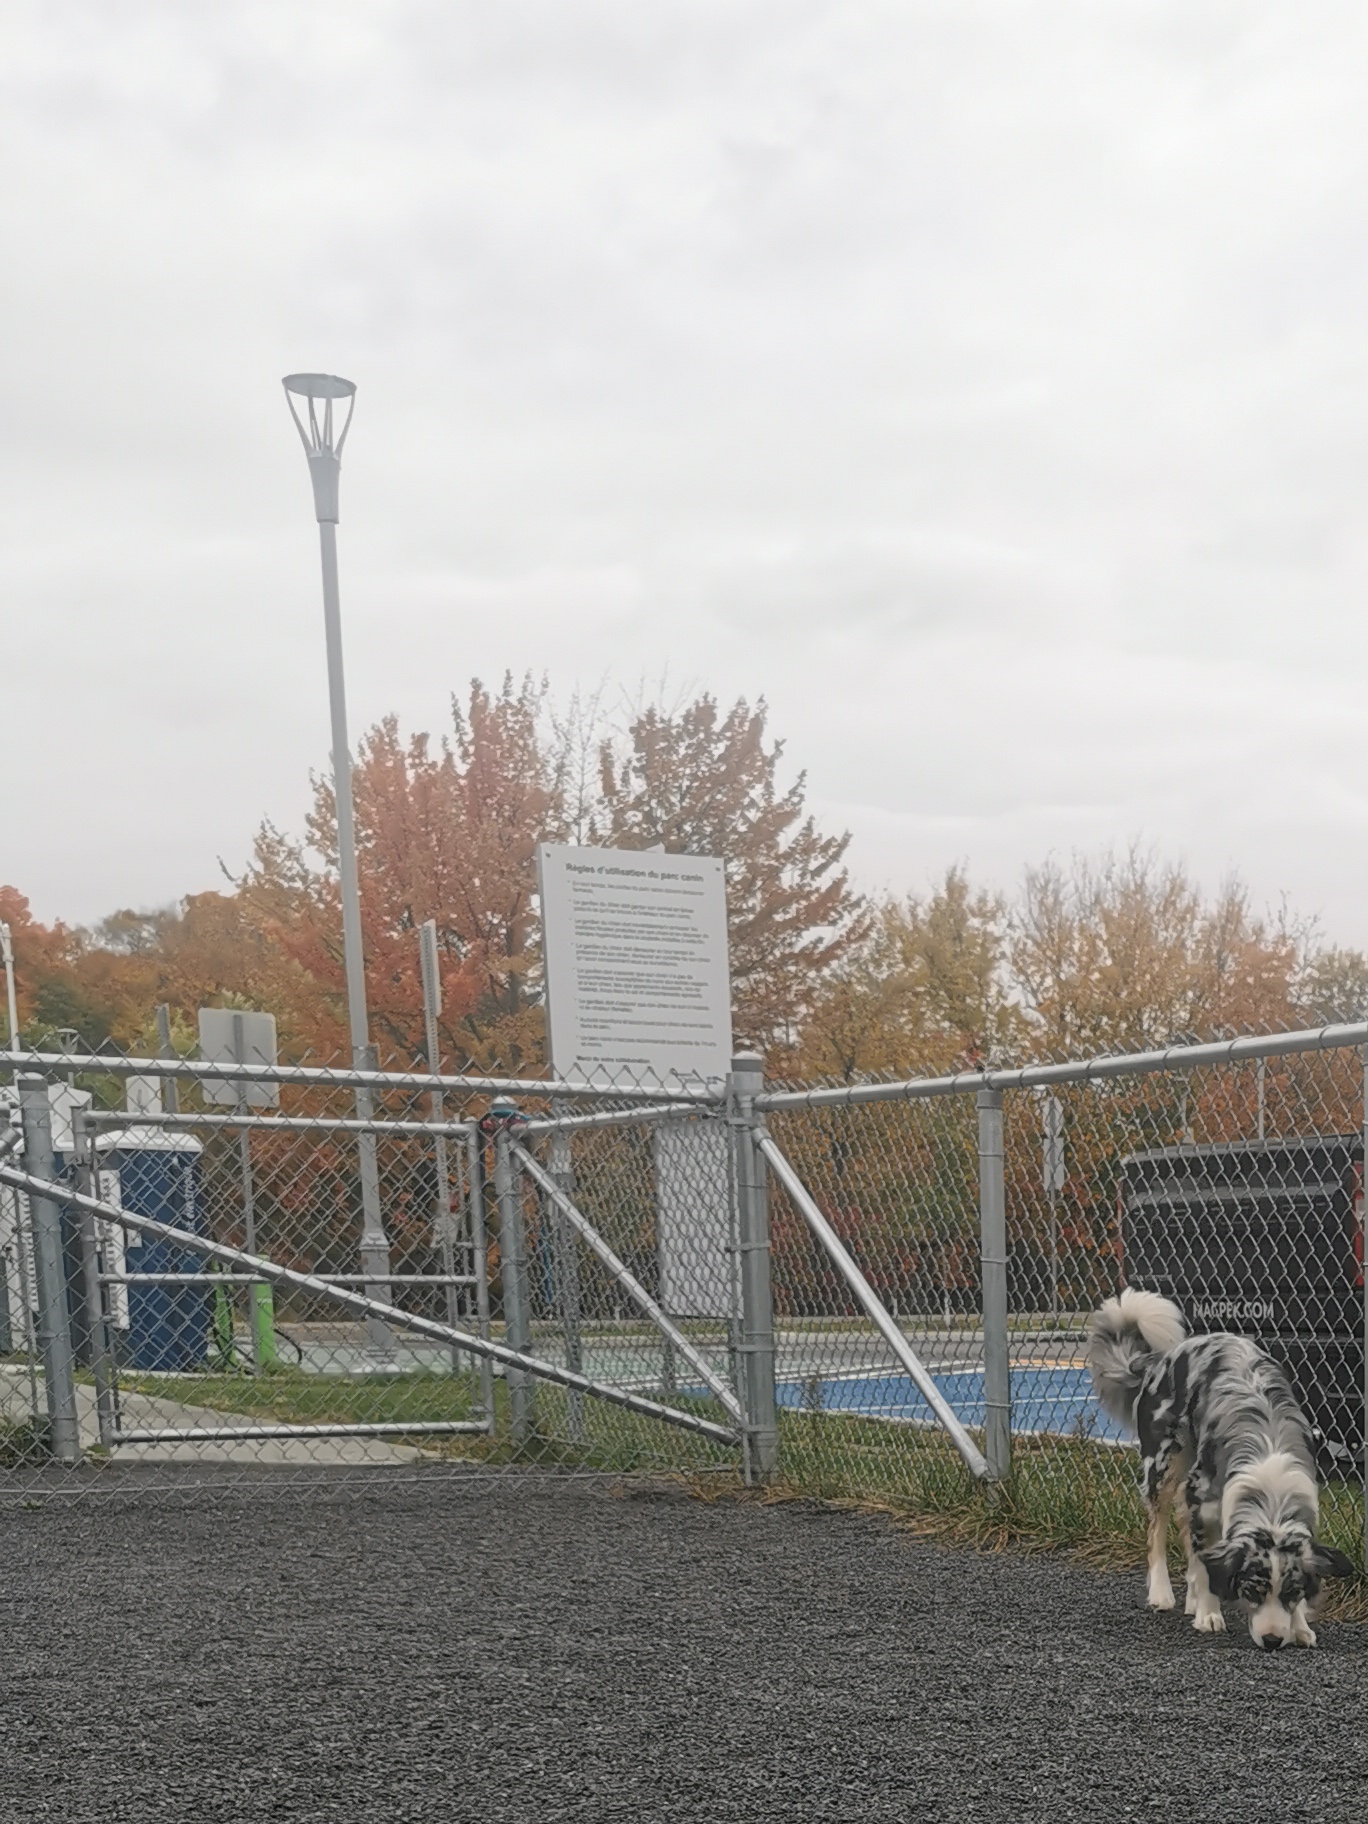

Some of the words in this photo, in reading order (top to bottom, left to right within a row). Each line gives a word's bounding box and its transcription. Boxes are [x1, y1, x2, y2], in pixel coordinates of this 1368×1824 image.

[661, 872, 679, 881] parc
[681, 874, 704, 882] canin
[1193, 1301, 1274, 1319] MACPEK.COM
